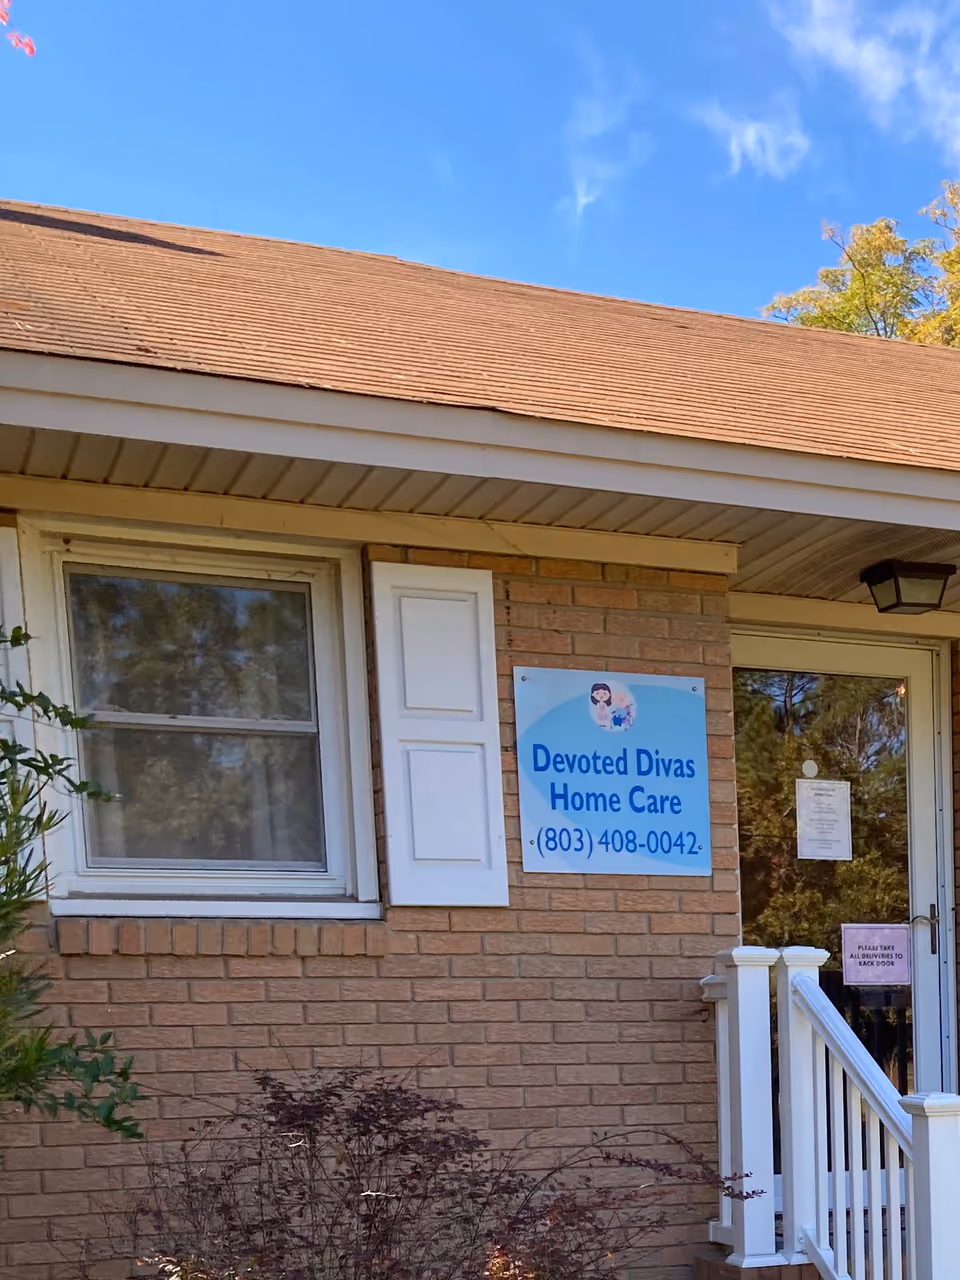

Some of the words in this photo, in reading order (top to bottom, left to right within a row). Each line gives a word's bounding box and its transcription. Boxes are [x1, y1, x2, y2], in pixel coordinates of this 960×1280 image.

[532, 743, 628, 776] Devoted
[635, 748, 696, 779] Divas
[549, 781, 621, 812] Home
[628, 785, 682, 815] Care
[536, 826, 594, 860] (803)
[597, 829, 699, 855] 408-0042
